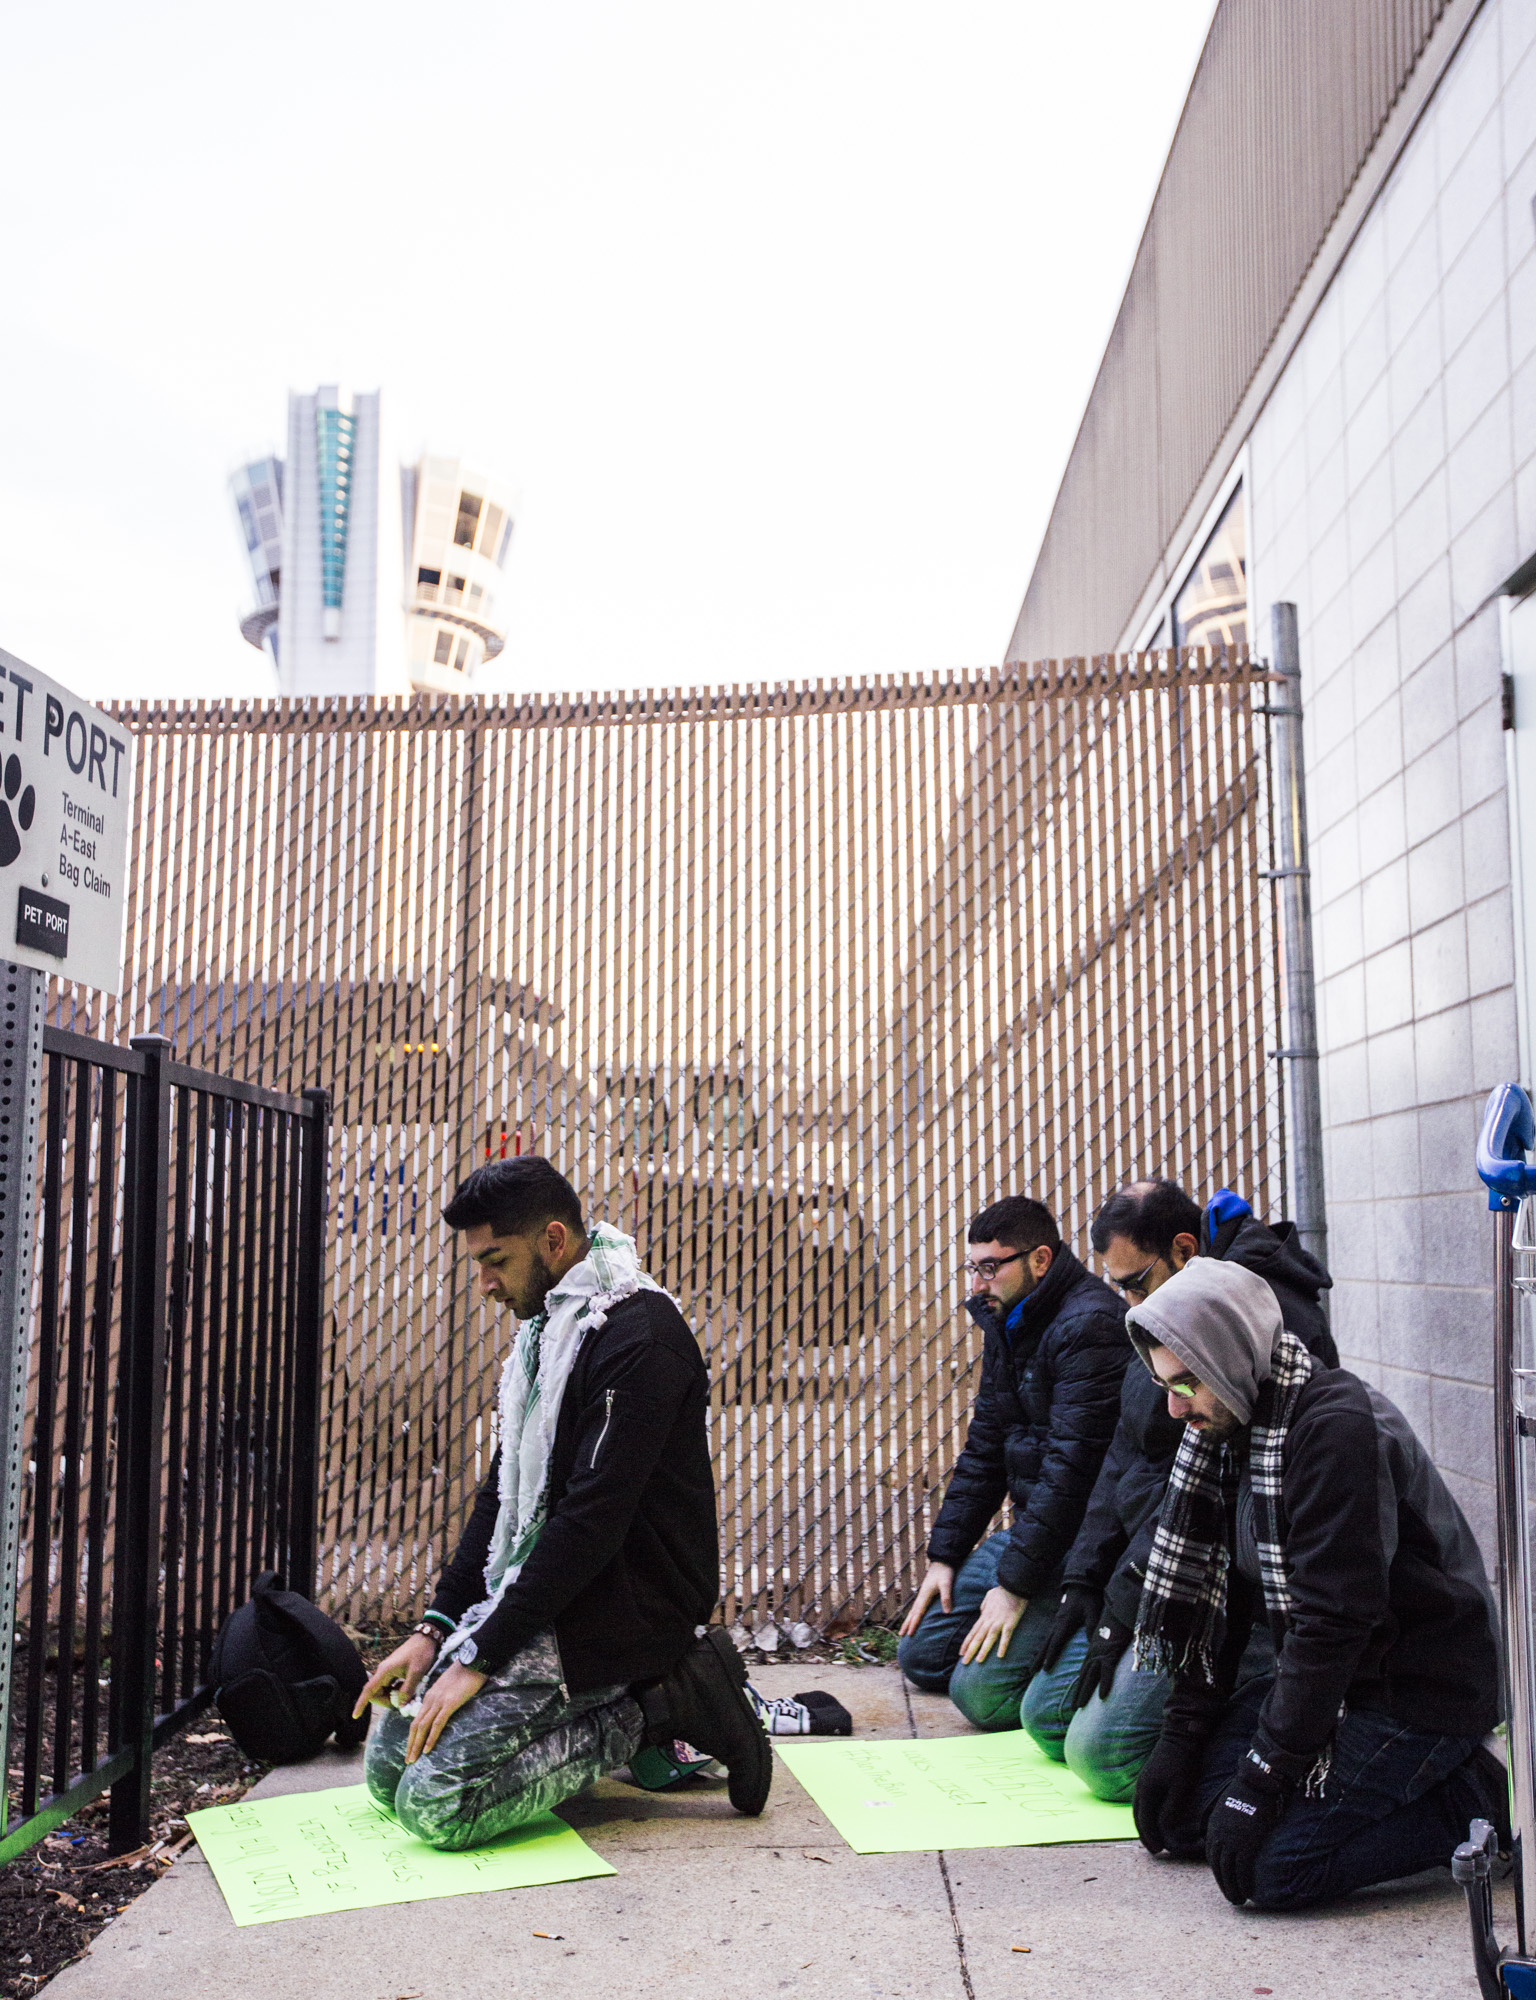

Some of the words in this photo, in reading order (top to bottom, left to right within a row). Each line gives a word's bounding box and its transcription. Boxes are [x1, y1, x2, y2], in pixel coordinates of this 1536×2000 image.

[43, 692, 126, 799] PORT
[61, 790, 105, 835] Terminal
[60, 823, 97, 861] A-East
[59, 852, 80, 887] Bag
[83, 866, 111, 898] Claim
[24, 904, 43, 925] PET
[45, 911, 68, 935] PORT
[927, 1778, 987, 1806] LIKE!
[951, 1755, 1081, 1818] AMERICA
[333, 1800, 402, 1842] AGAINST
[296, 1816, 353, 1878] PHILADELPHIA
[382, 1849, 424, 1884] STANDS
[463, 1850, 503, 1872] THE
